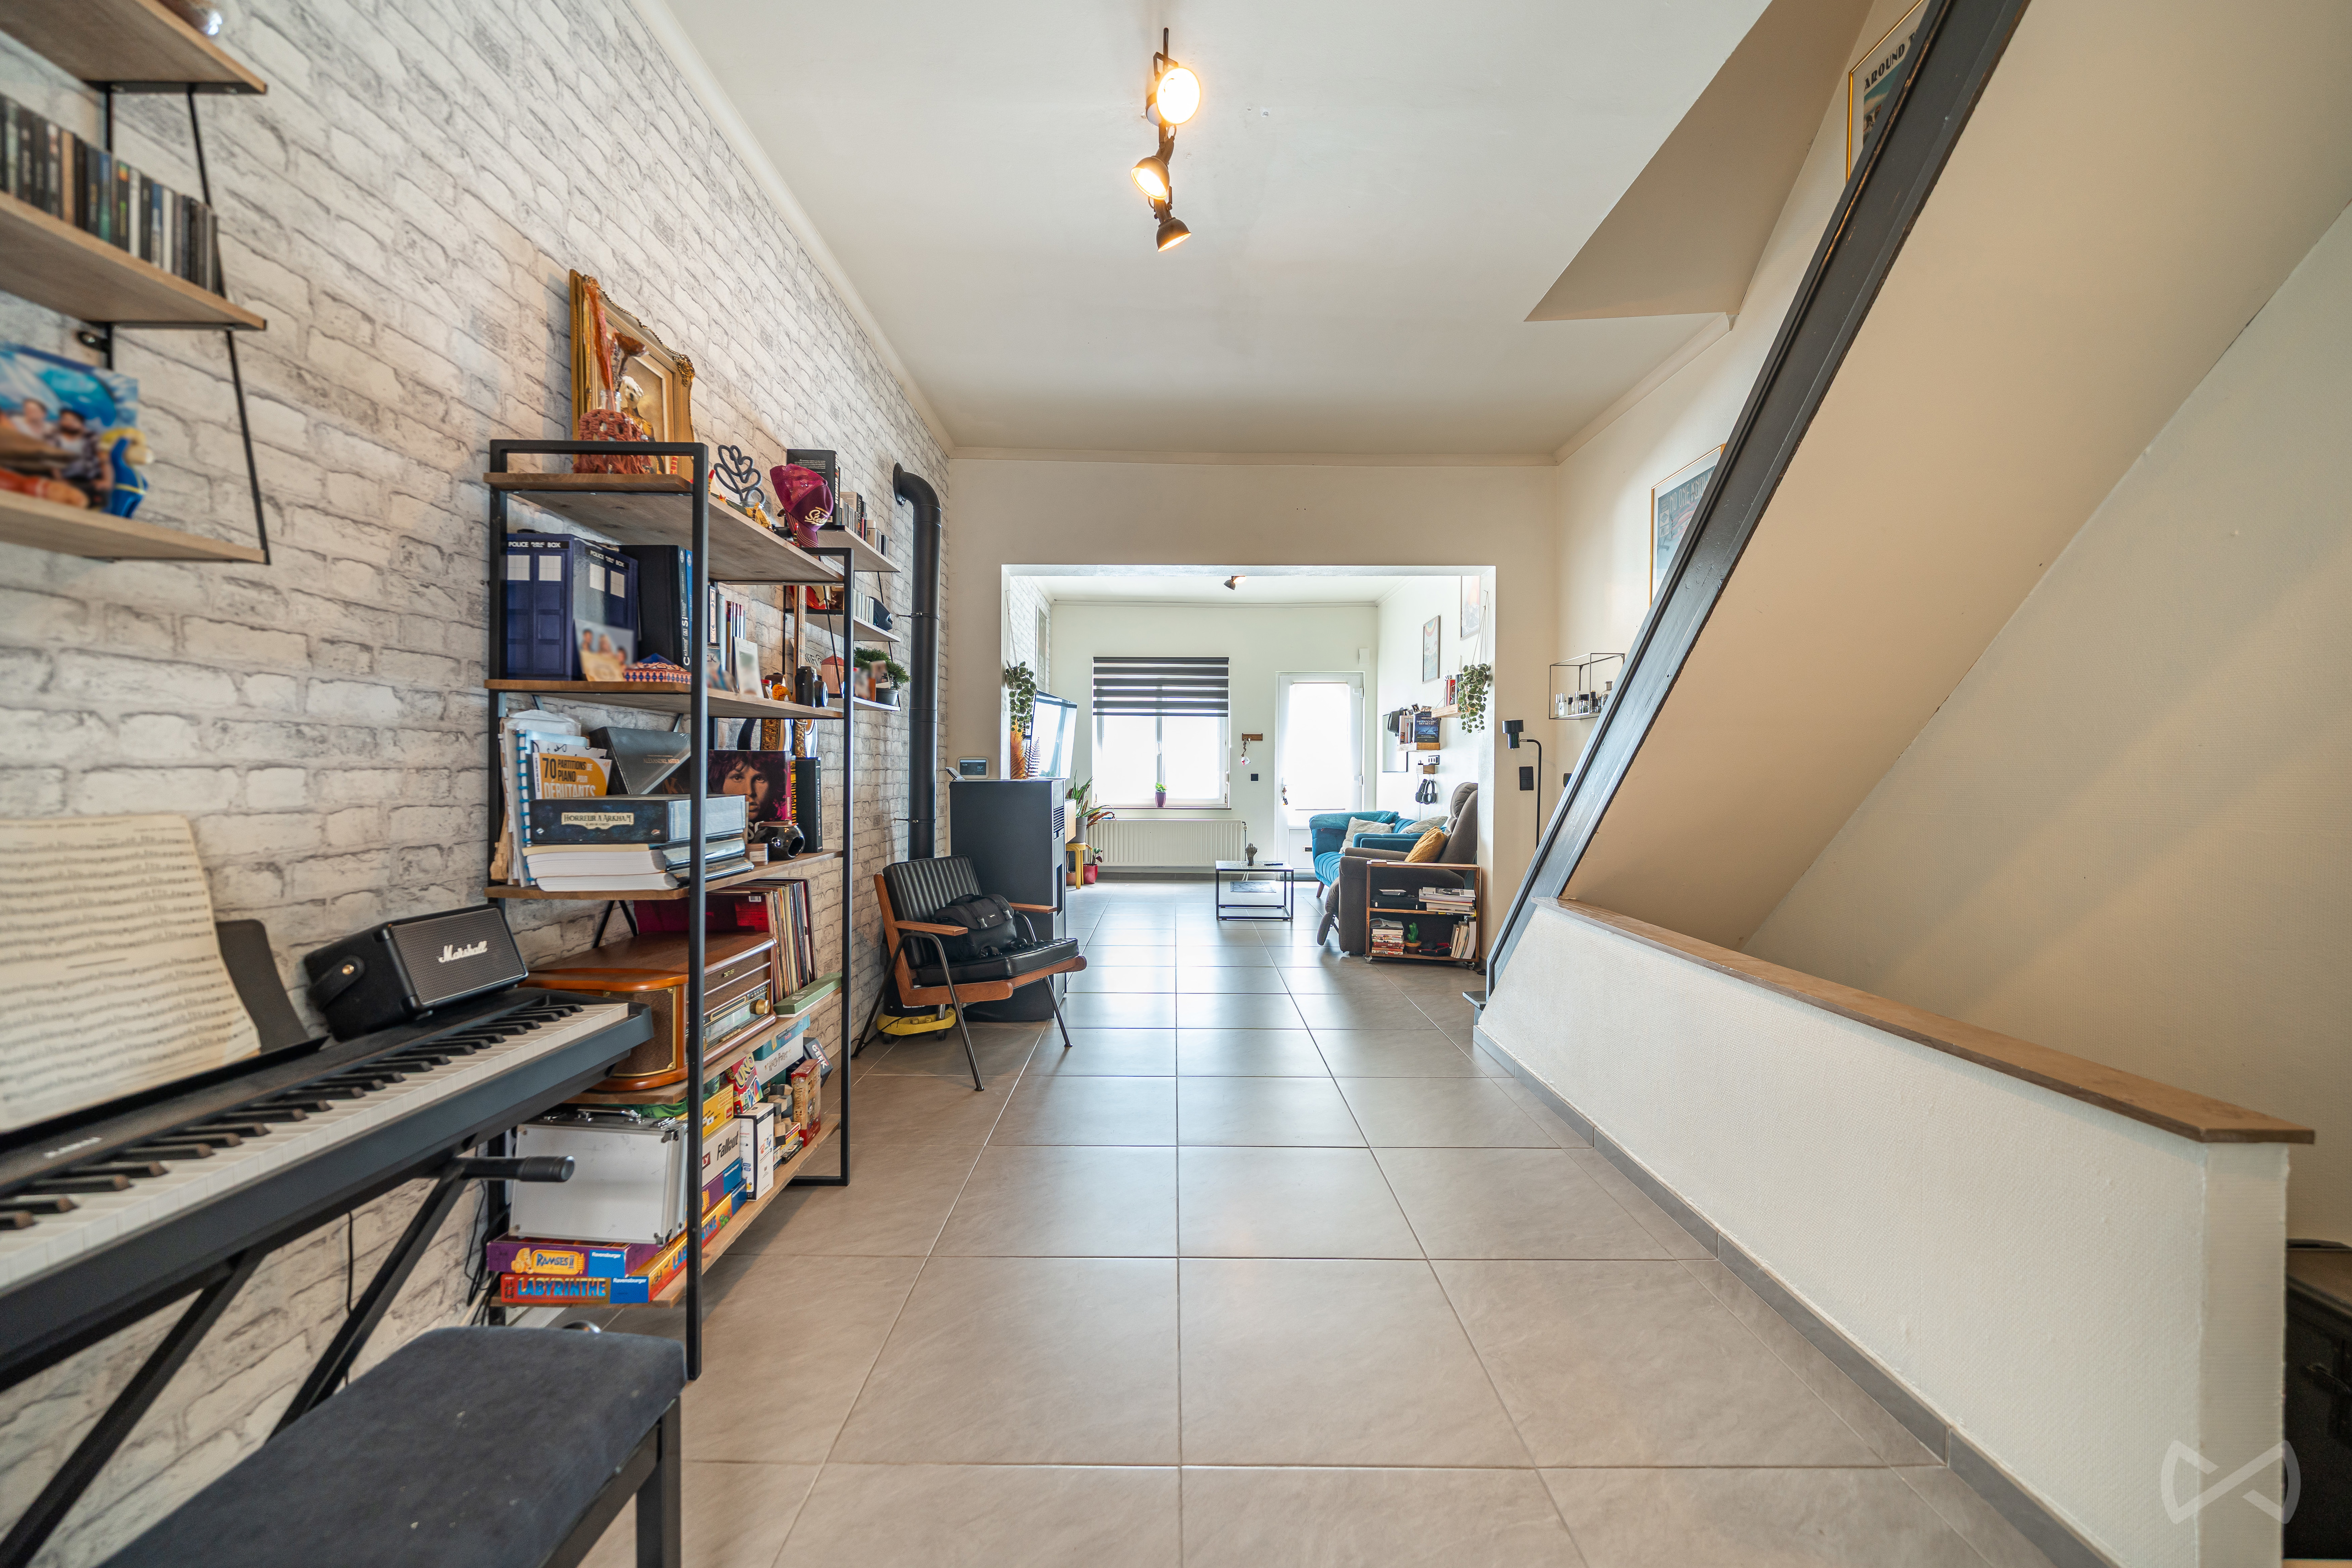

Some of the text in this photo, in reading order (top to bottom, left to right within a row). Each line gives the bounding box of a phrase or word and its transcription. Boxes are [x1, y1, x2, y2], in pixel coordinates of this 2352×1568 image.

[1864, 44, 1905, 92] AROUND
[1670, 492, 1677, 513] NO
[1679, 484, 1690, 508] ONE
[590, 550, 605, 560] POLICE
[542, 757, 556, 779] 70
[557, 759, 586, 770] PARTITIONS
[557, 770, 576, 782] PIANO
[543, 779, 596, 799] DÉBUTANTS
[603, 814, 632, 823] ARKHAM
[438, 940, 488, 963] Marshall
[734, 1053, 754, 1088] UNO
[769, 1051, 788, 1071] Harry Potter
[717, 1131, 739, 1161] Fallout
[536, 1253, 568, 1267] RAMSES
[517, 1277, 606, 1297] LABYRINTHE
